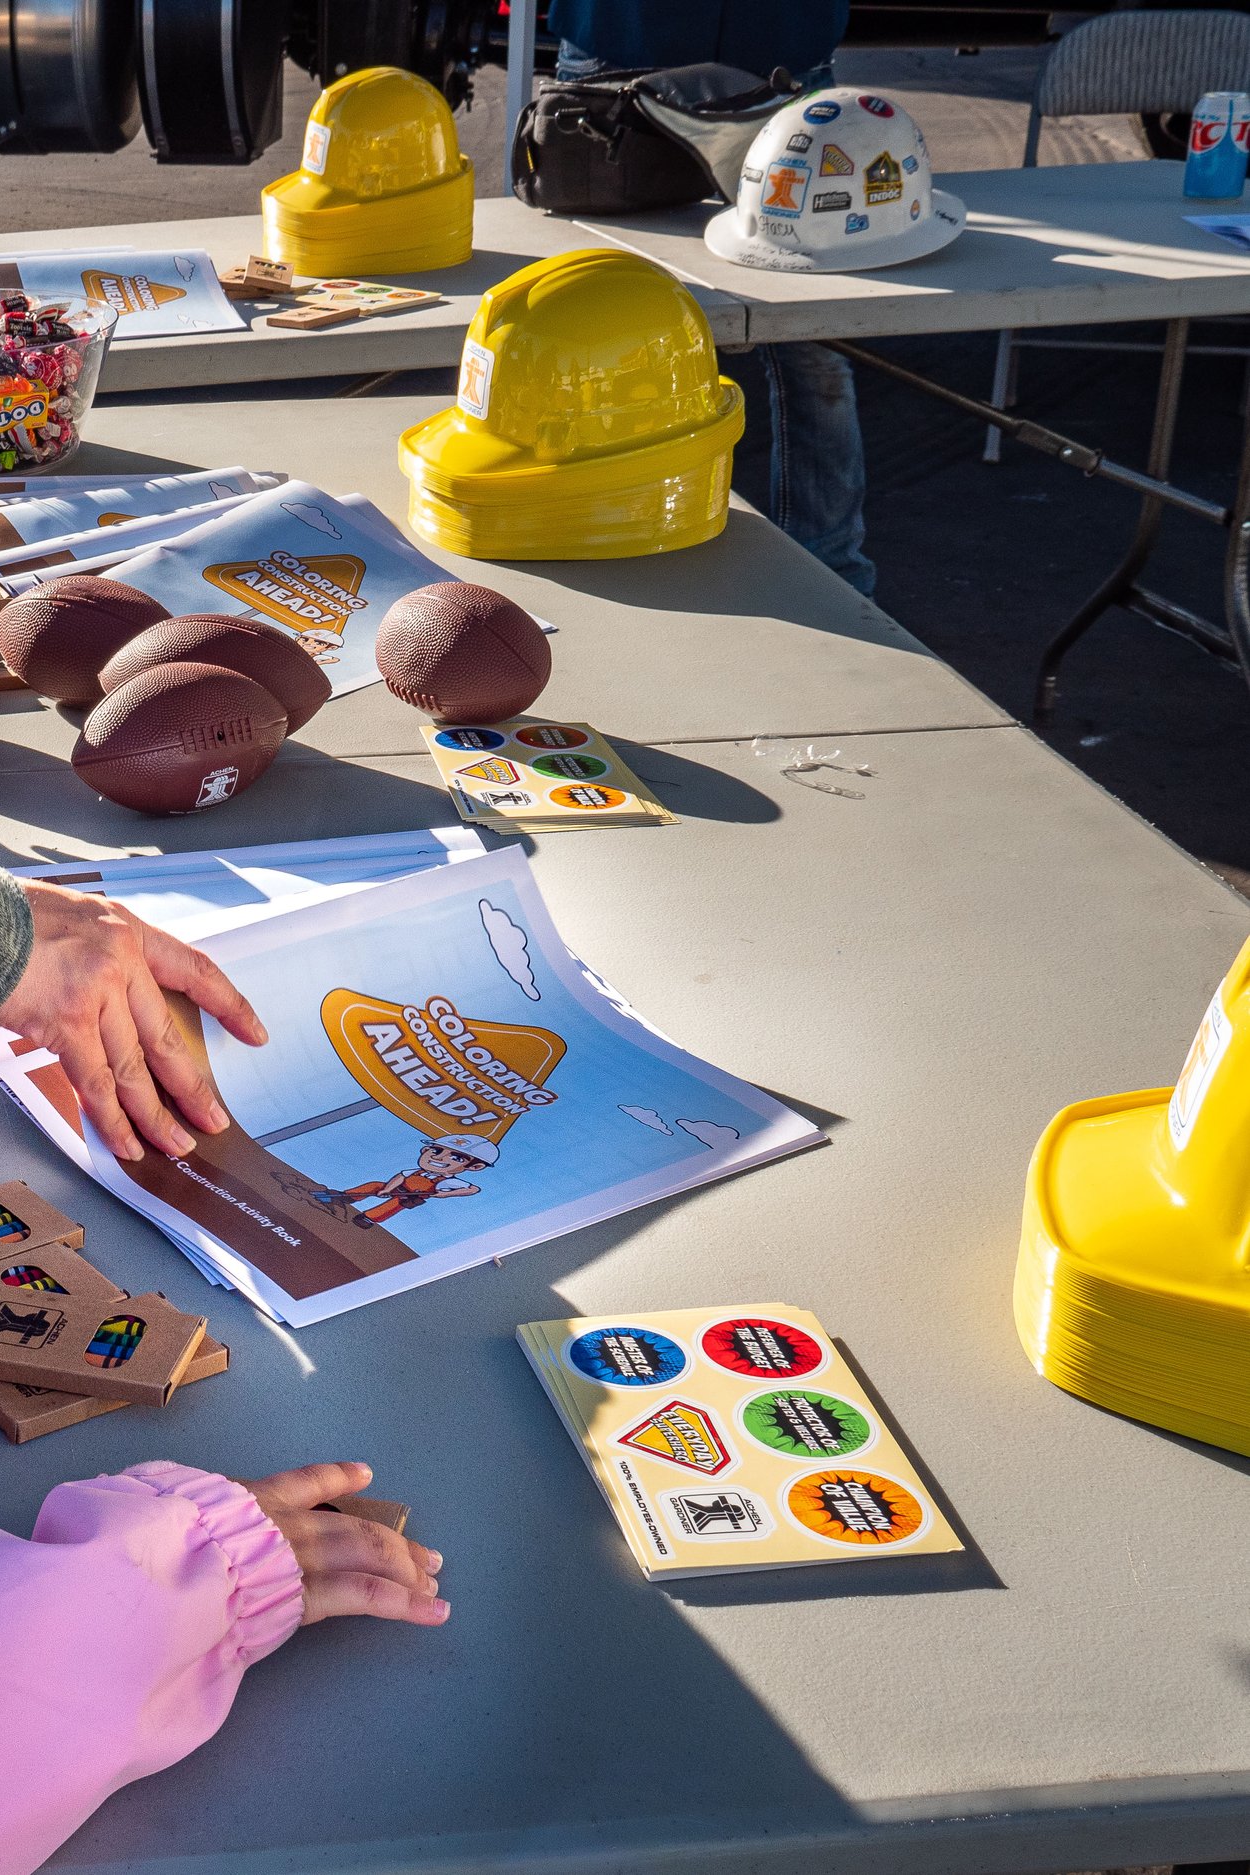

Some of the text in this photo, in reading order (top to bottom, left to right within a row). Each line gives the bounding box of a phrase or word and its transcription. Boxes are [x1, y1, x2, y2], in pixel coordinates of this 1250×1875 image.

[236, 571, 335, 624] AHEAD!
[257, 560, 353, 616] CONSTRUCTION
[271, 551, 368, 610] COLORING
[210, 766, 234, 776] ACHEN
[362, 1023, 499, 1126] AHEAD!
[402, 1005, 529, 1115] CONSTRUCTION
[428, 997, 556, 1105] COLORING
[176, 1161, 302, 1247] Construction Activity Book
[47, 1318, 69, 1345] ACHEN
[603, 1336, 621, 1348] THE
[735, 1327, 773, 1370] THE BUDGET
[753, 1327, 792, 1369] DEFENDER OF
[618, 1336, 655, 1376] MASTER OF
[650, 1418, 690, 1463] SUPERHERO
[660, 1411, 716, 1470] EVERYDAY
[790, 1397, 841, 1450] PROTECTOR OF
[793, 1425, 821, 1451] WELFARE
[619, 1460, 668, 1555] 100% EMPLOYEE-OWNED
[669, 1497, 693, 1534] GARDNER
[743, 1498, 764, 1525] ACHEN
[820, 1483, 873, 1531] OF VALUE
[843, 1482, 893, 1530] CHAMPION
